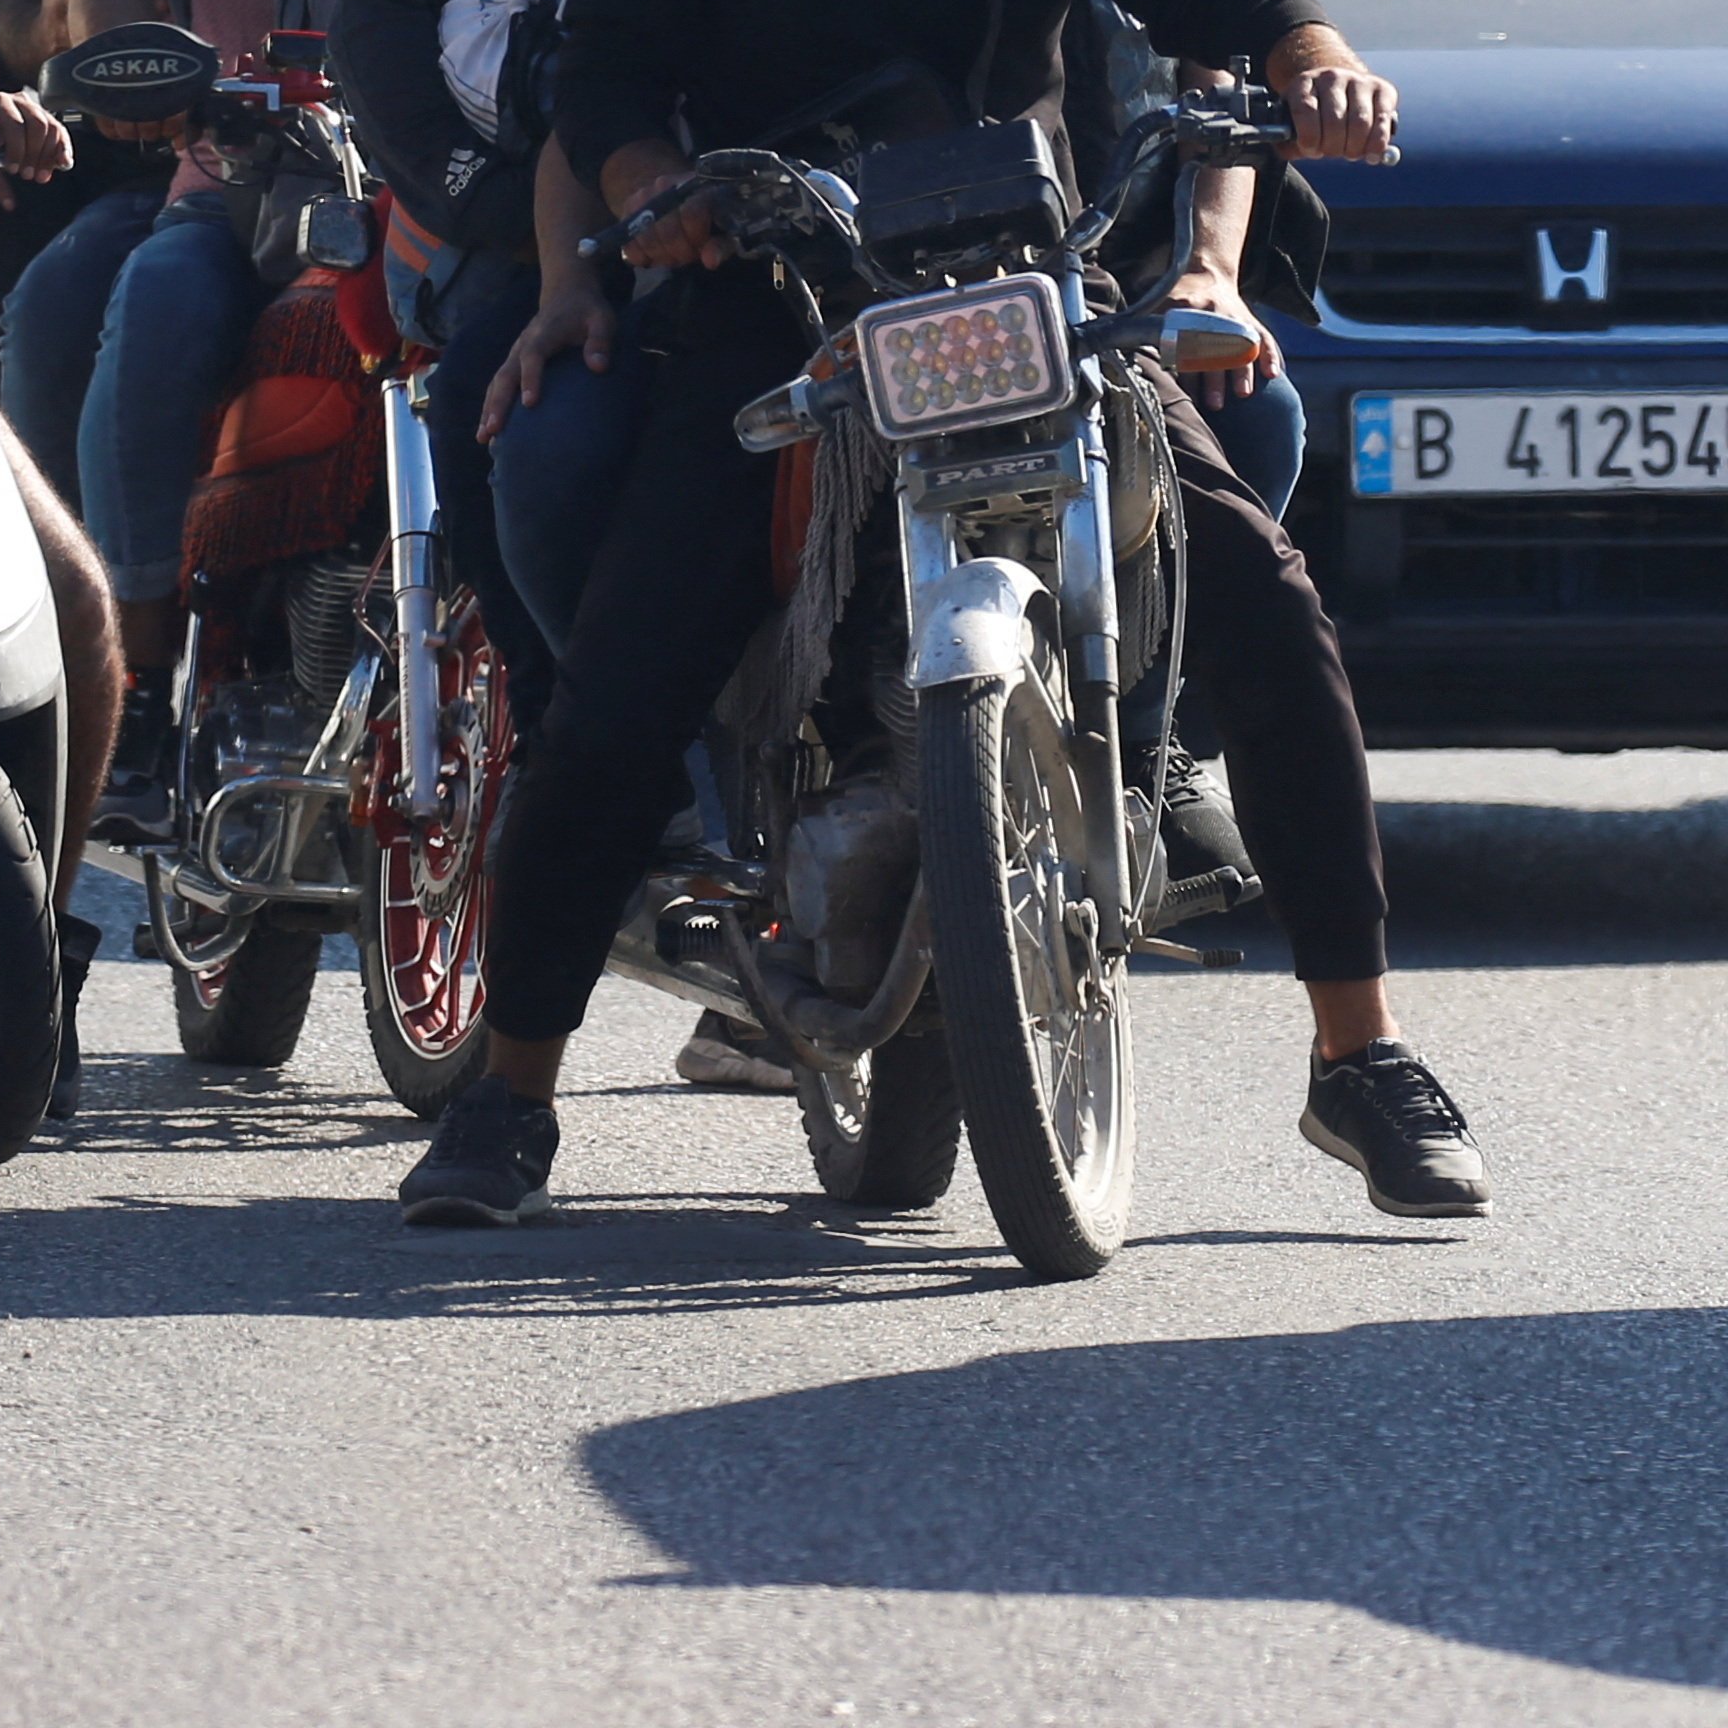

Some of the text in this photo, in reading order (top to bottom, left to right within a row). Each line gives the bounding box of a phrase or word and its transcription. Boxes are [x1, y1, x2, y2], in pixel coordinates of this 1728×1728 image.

[93, 58, 179, 77] ASKAR
[448, 157, 486, 196] adidas
[1414, 408, 1454, 480] B
[936, 457, 1046, 486] PART
